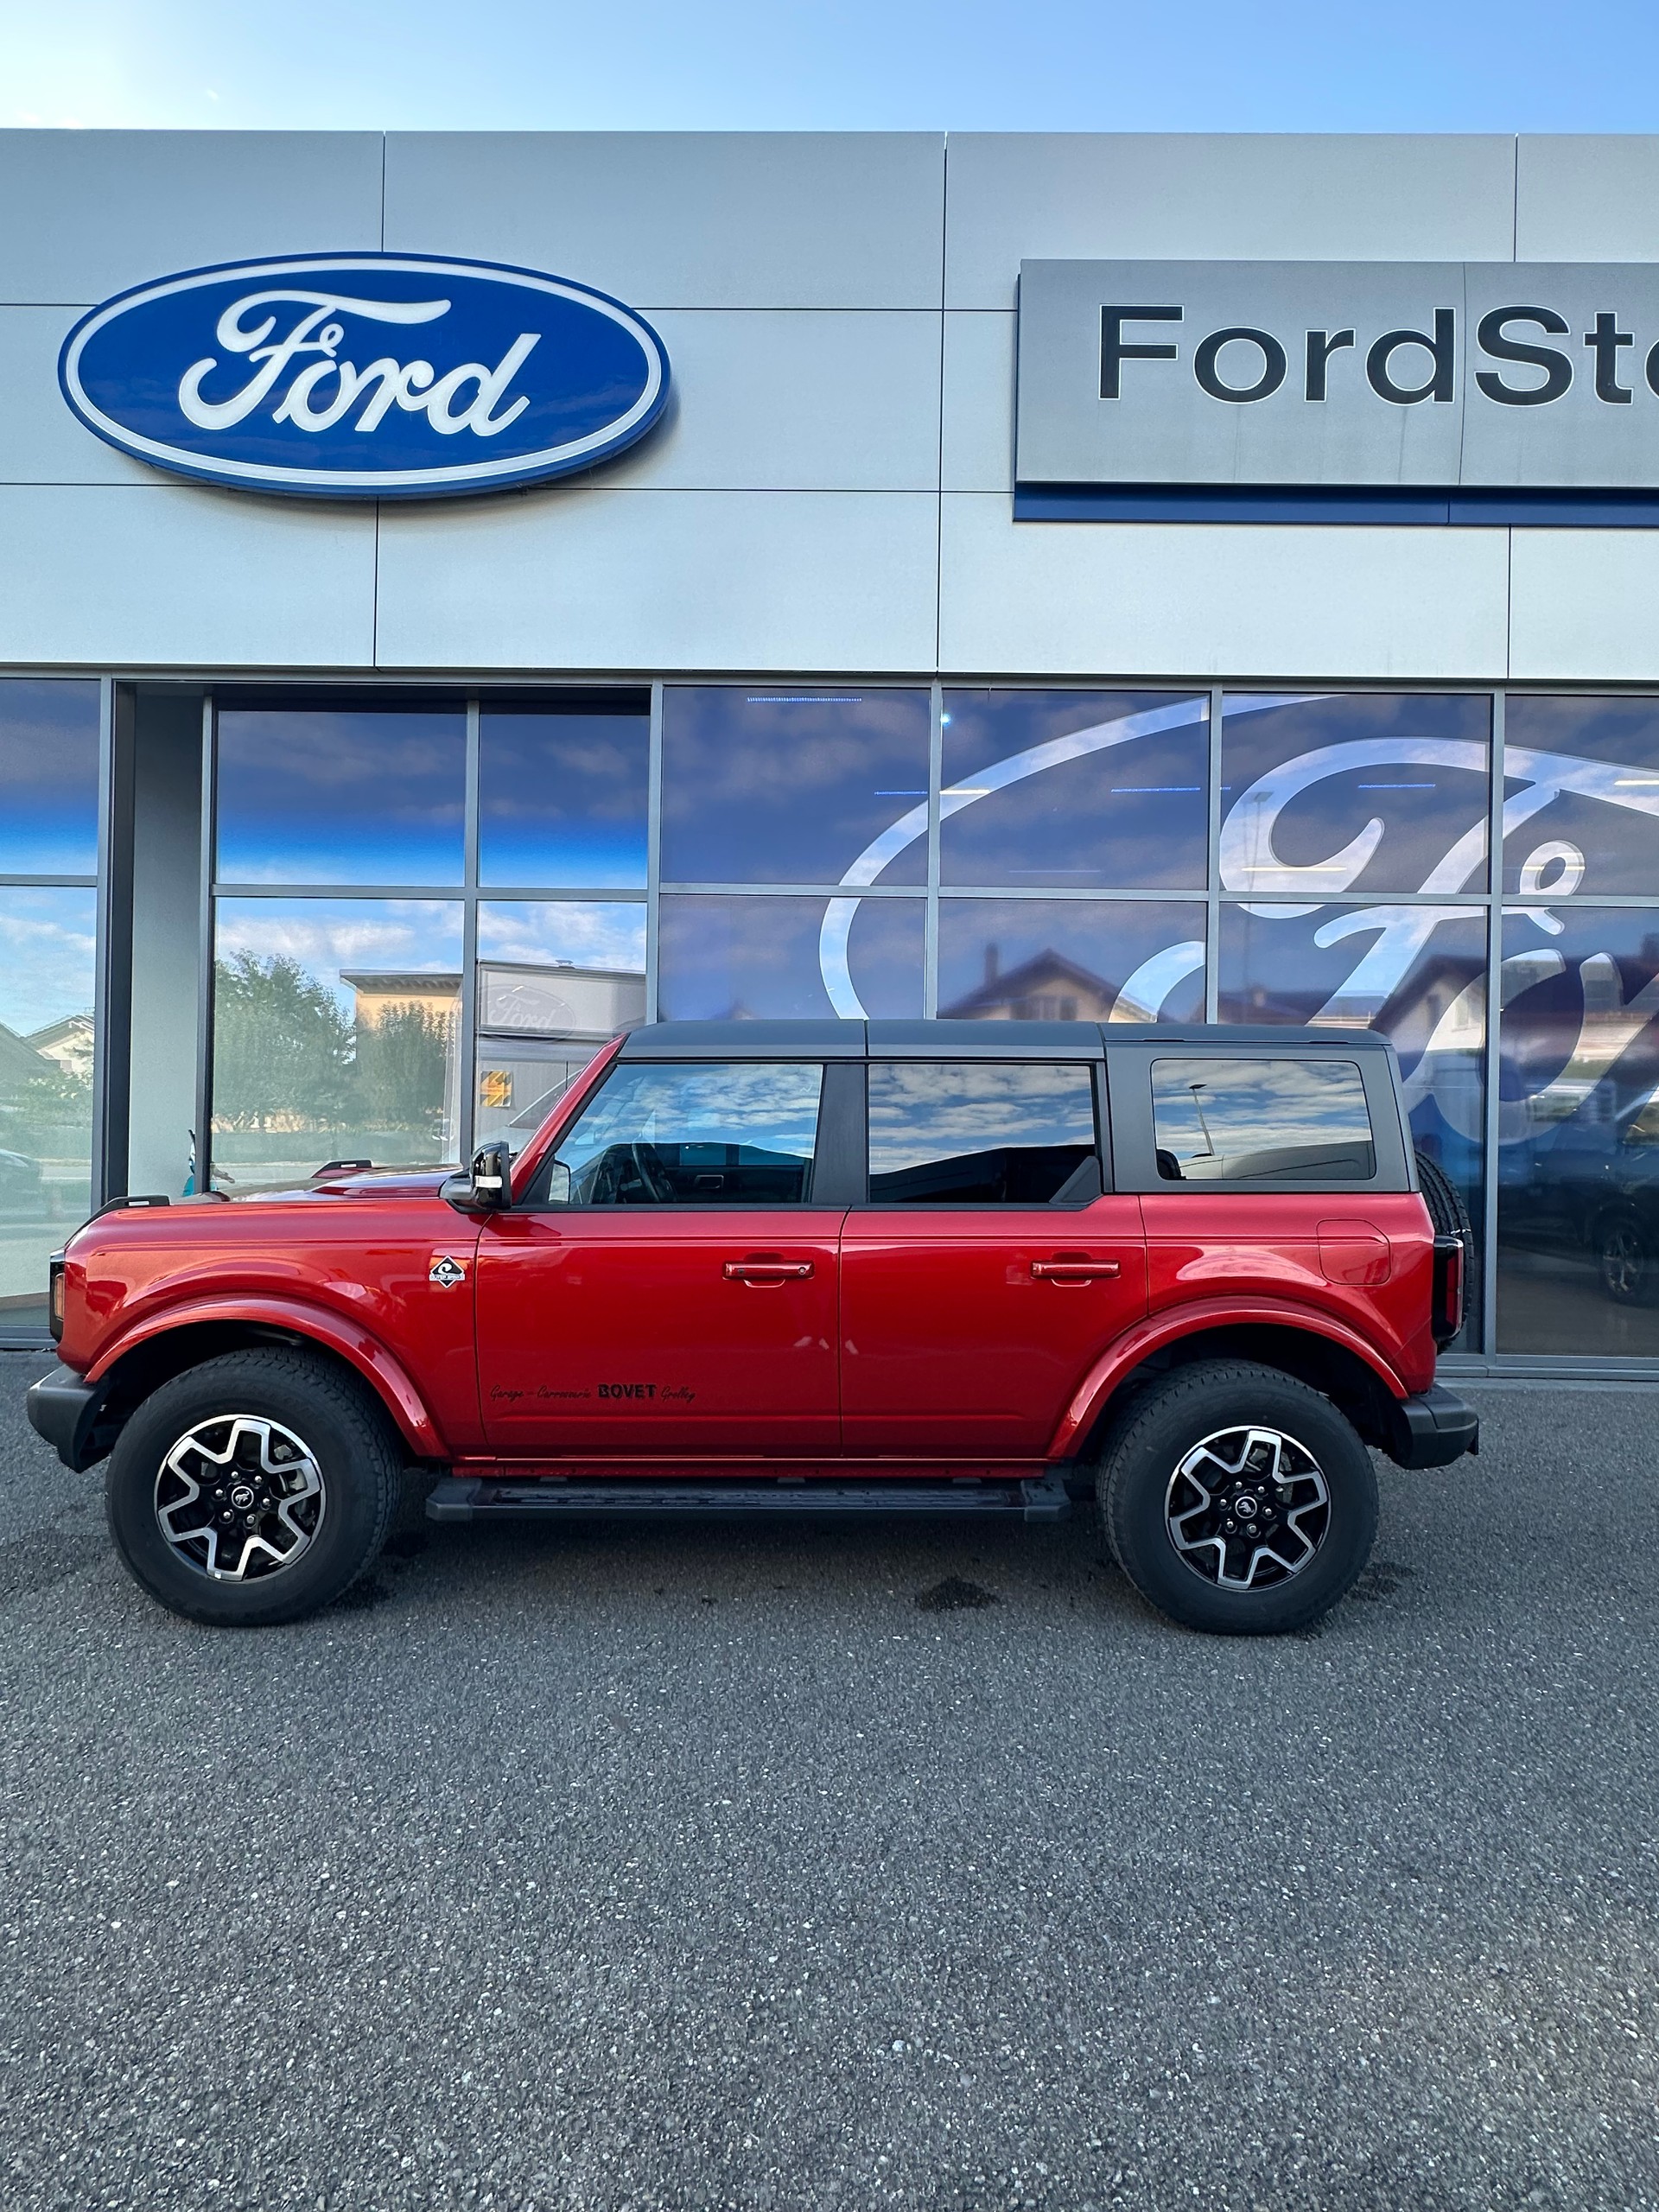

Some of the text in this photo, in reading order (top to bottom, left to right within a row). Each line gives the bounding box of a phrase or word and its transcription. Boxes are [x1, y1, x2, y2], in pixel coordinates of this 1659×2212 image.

[179, 289, 542, 437] Ford
[1098, 303, 1659, 407] FordSt
[489, 993, 557, 1034] Ford
[598, 1383, 657, 1399] BOVET
